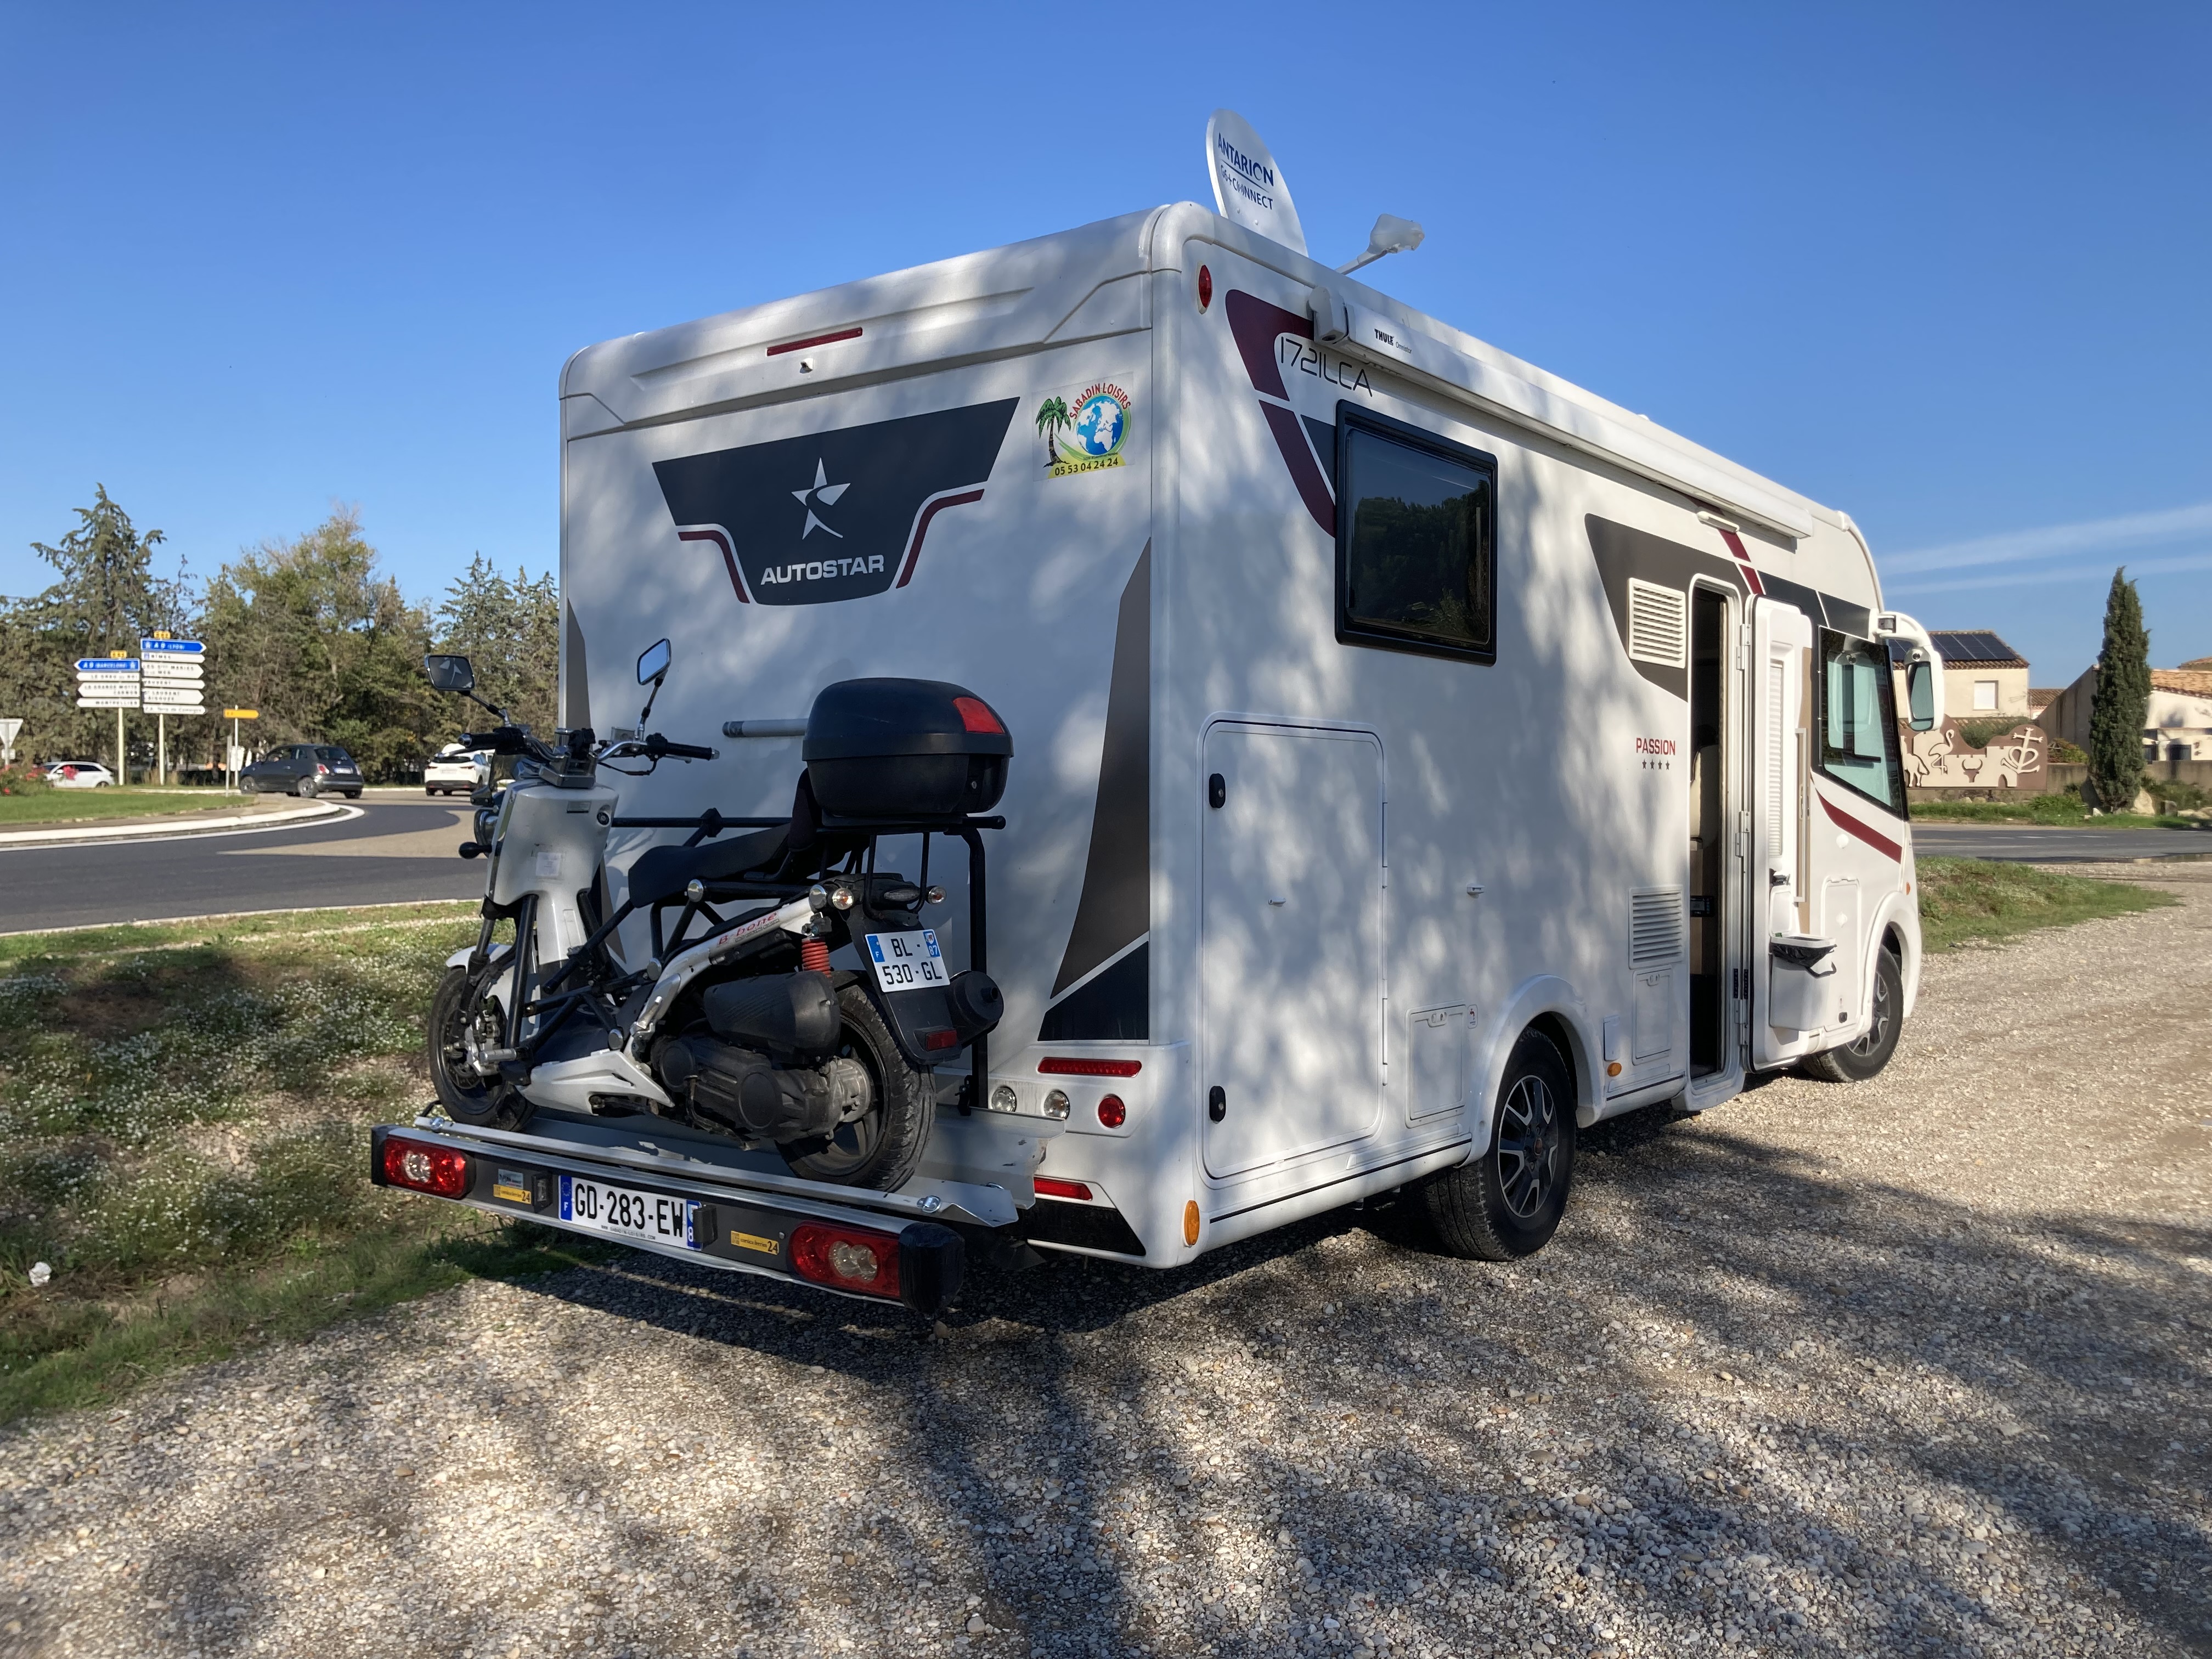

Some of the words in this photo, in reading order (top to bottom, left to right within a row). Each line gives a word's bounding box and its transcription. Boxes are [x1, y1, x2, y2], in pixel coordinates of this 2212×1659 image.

[1218, 132, 1274, 187] ANTARION
[1374, 328, 1394, 346] THULE
[1070, 383, 1101, 420] SABADIN
[1102, 382, 1131, 410] LOISIRS
[1054, 466, 1065, 476] 05
[1068, 464, 1079, 474] 53
[1080, 461, 1092, 471] 04
[1093, 459, 1105, 469] 24
[1107, 457, 1119, 466] 24
[760, 554, 884, 585] AUTOSTAR
[1636, 737, 1675, 755] PASSION
[928, 945, 938, 956] 87
[882, 961, 943, 985] 530-GL
[563, 1201, 569, 1211] F
[575, 1183, 683, 1238] GD-283-EW
[768, 1240, 778, 1255] 24
